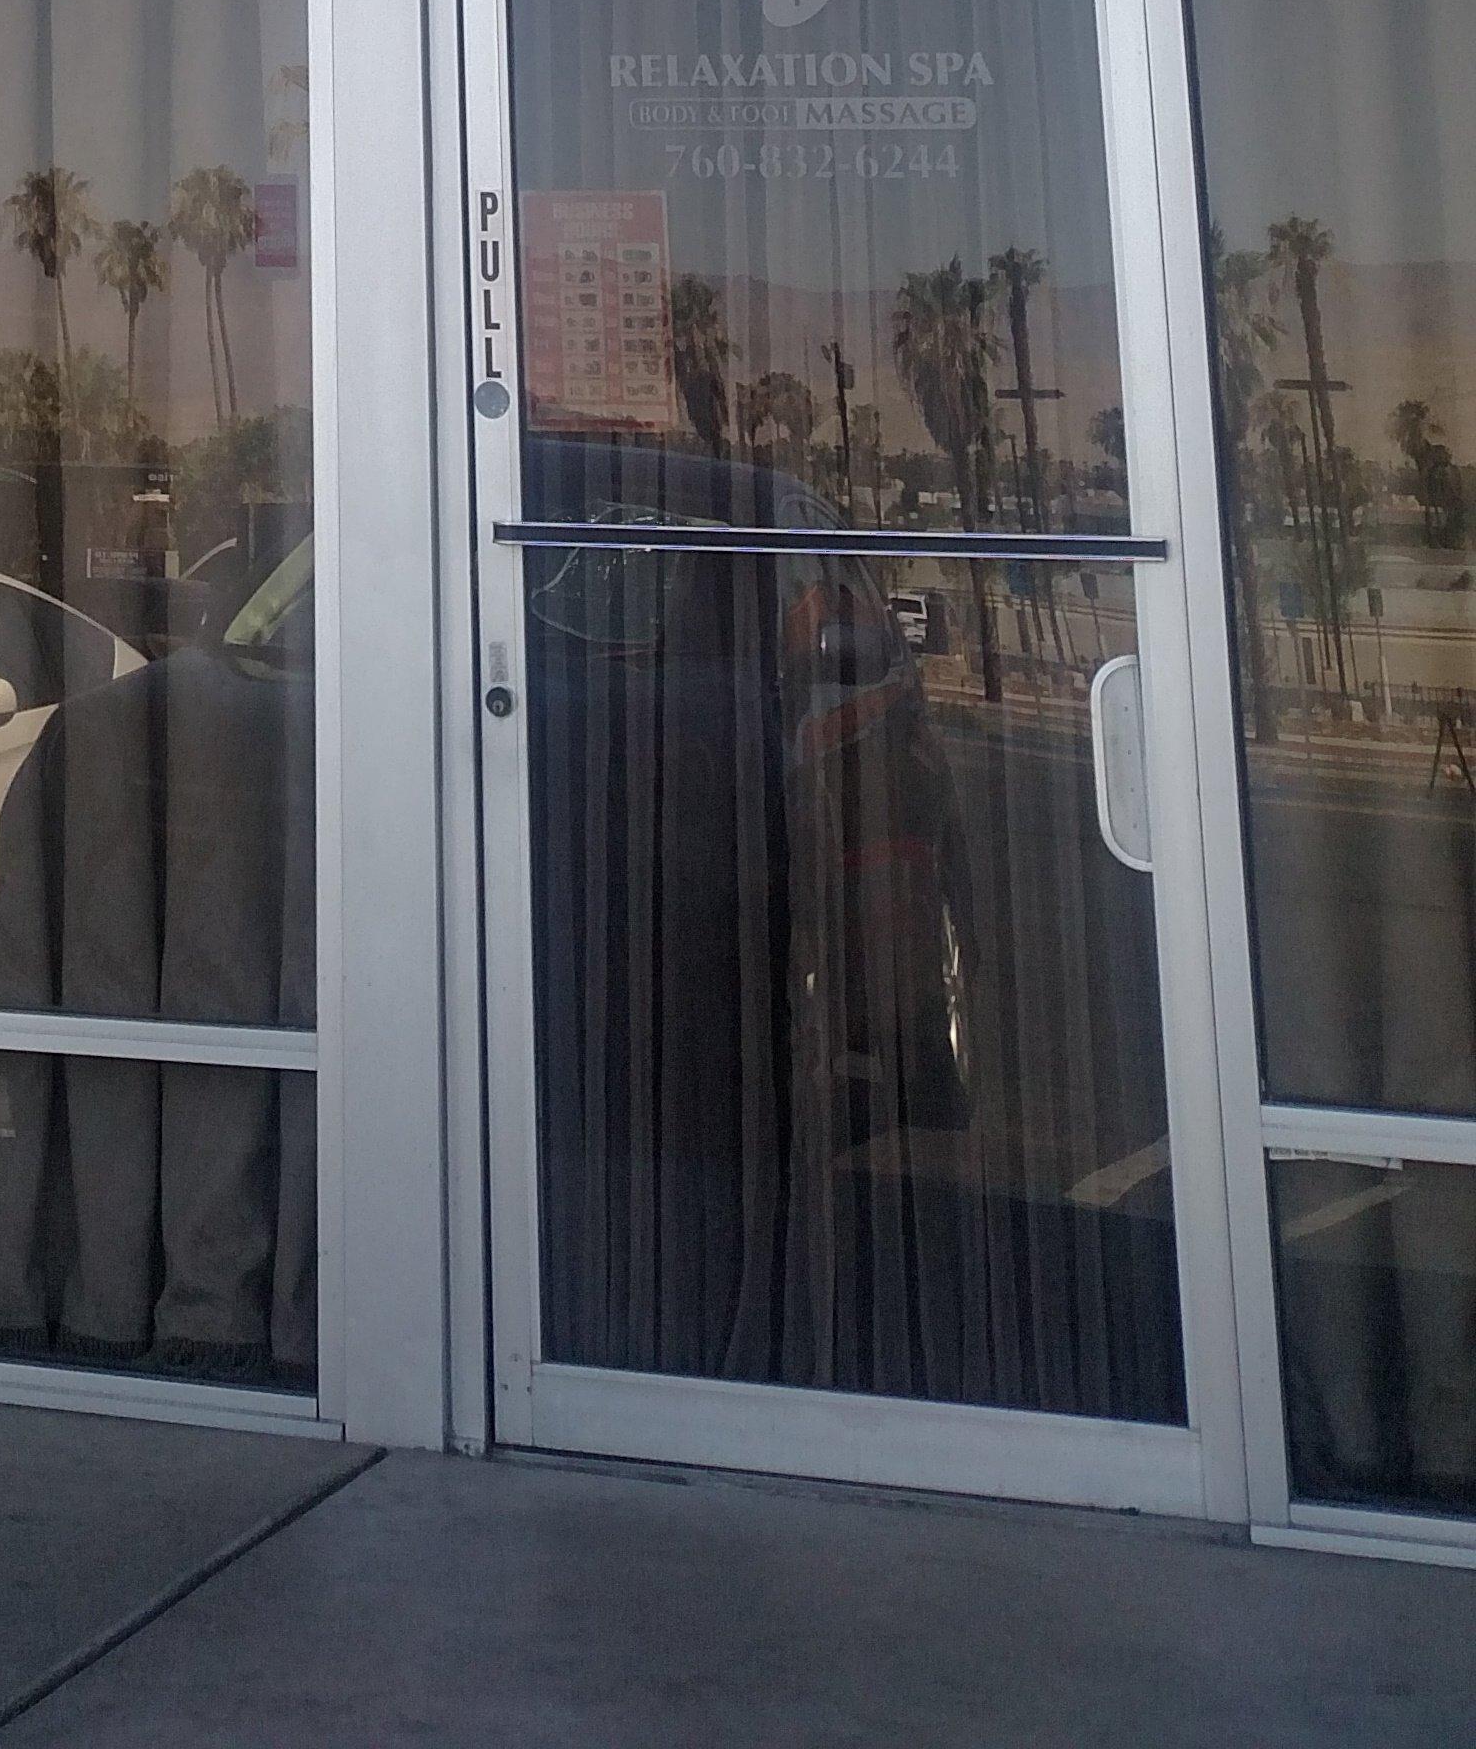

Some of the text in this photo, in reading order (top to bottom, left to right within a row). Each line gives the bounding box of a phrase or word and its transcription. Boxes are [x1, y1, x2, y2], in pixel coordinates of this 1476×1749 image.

[609, 50, 995, 88] RELAXATION SPA
[639, 102, 698, 124] BODY
[707, 102, 722, 124] &
[805, 101, 967, 126] MASSAGE
[664, 143, 961, 180] 760-832-6244
[479, 191, 503, 380] PULL
